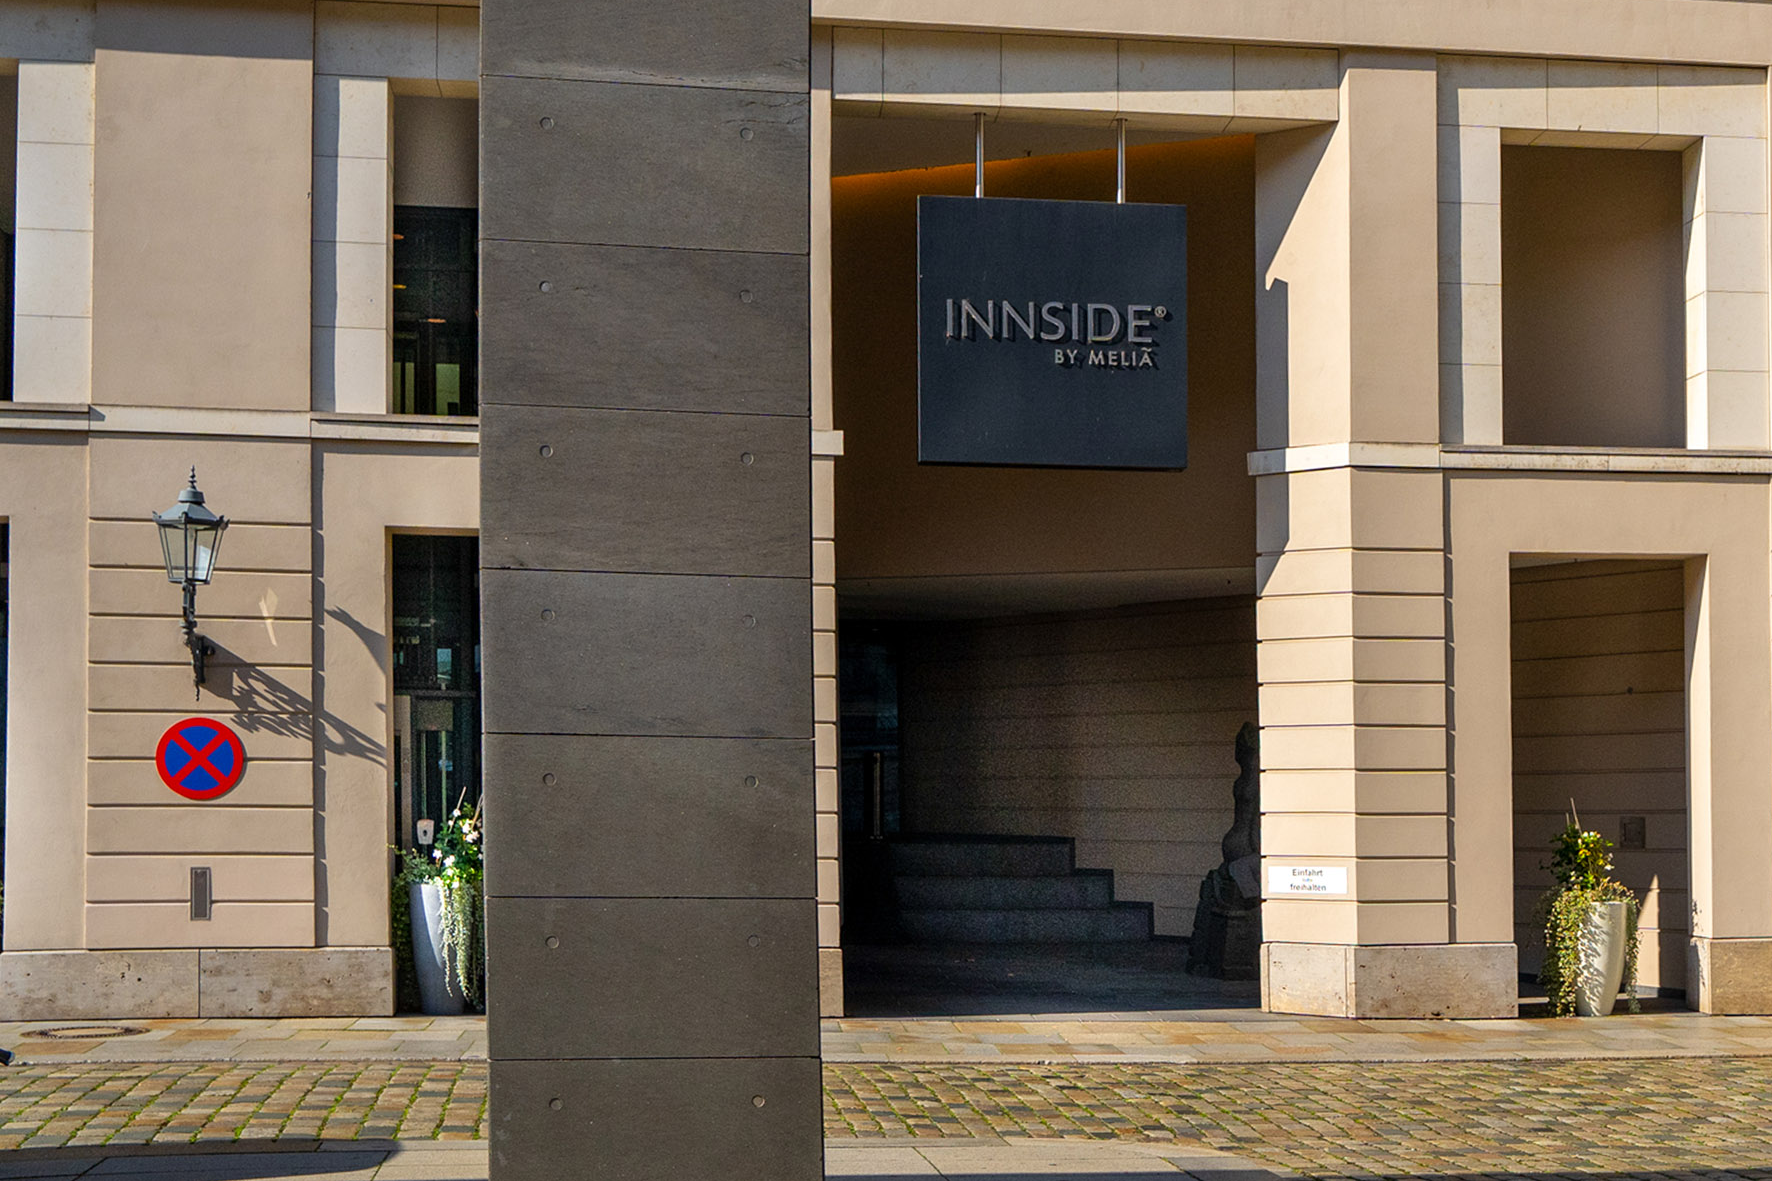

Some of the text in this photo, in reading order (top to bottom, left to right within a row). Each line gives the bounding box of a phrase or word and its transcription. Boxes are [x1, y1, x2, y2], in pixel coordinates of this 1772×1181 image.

[1054, 348, 1078, 365] BY
[1292, 868, 1324, 877] Einfahrt
[1290, 883, 1326, 891] freihalten
